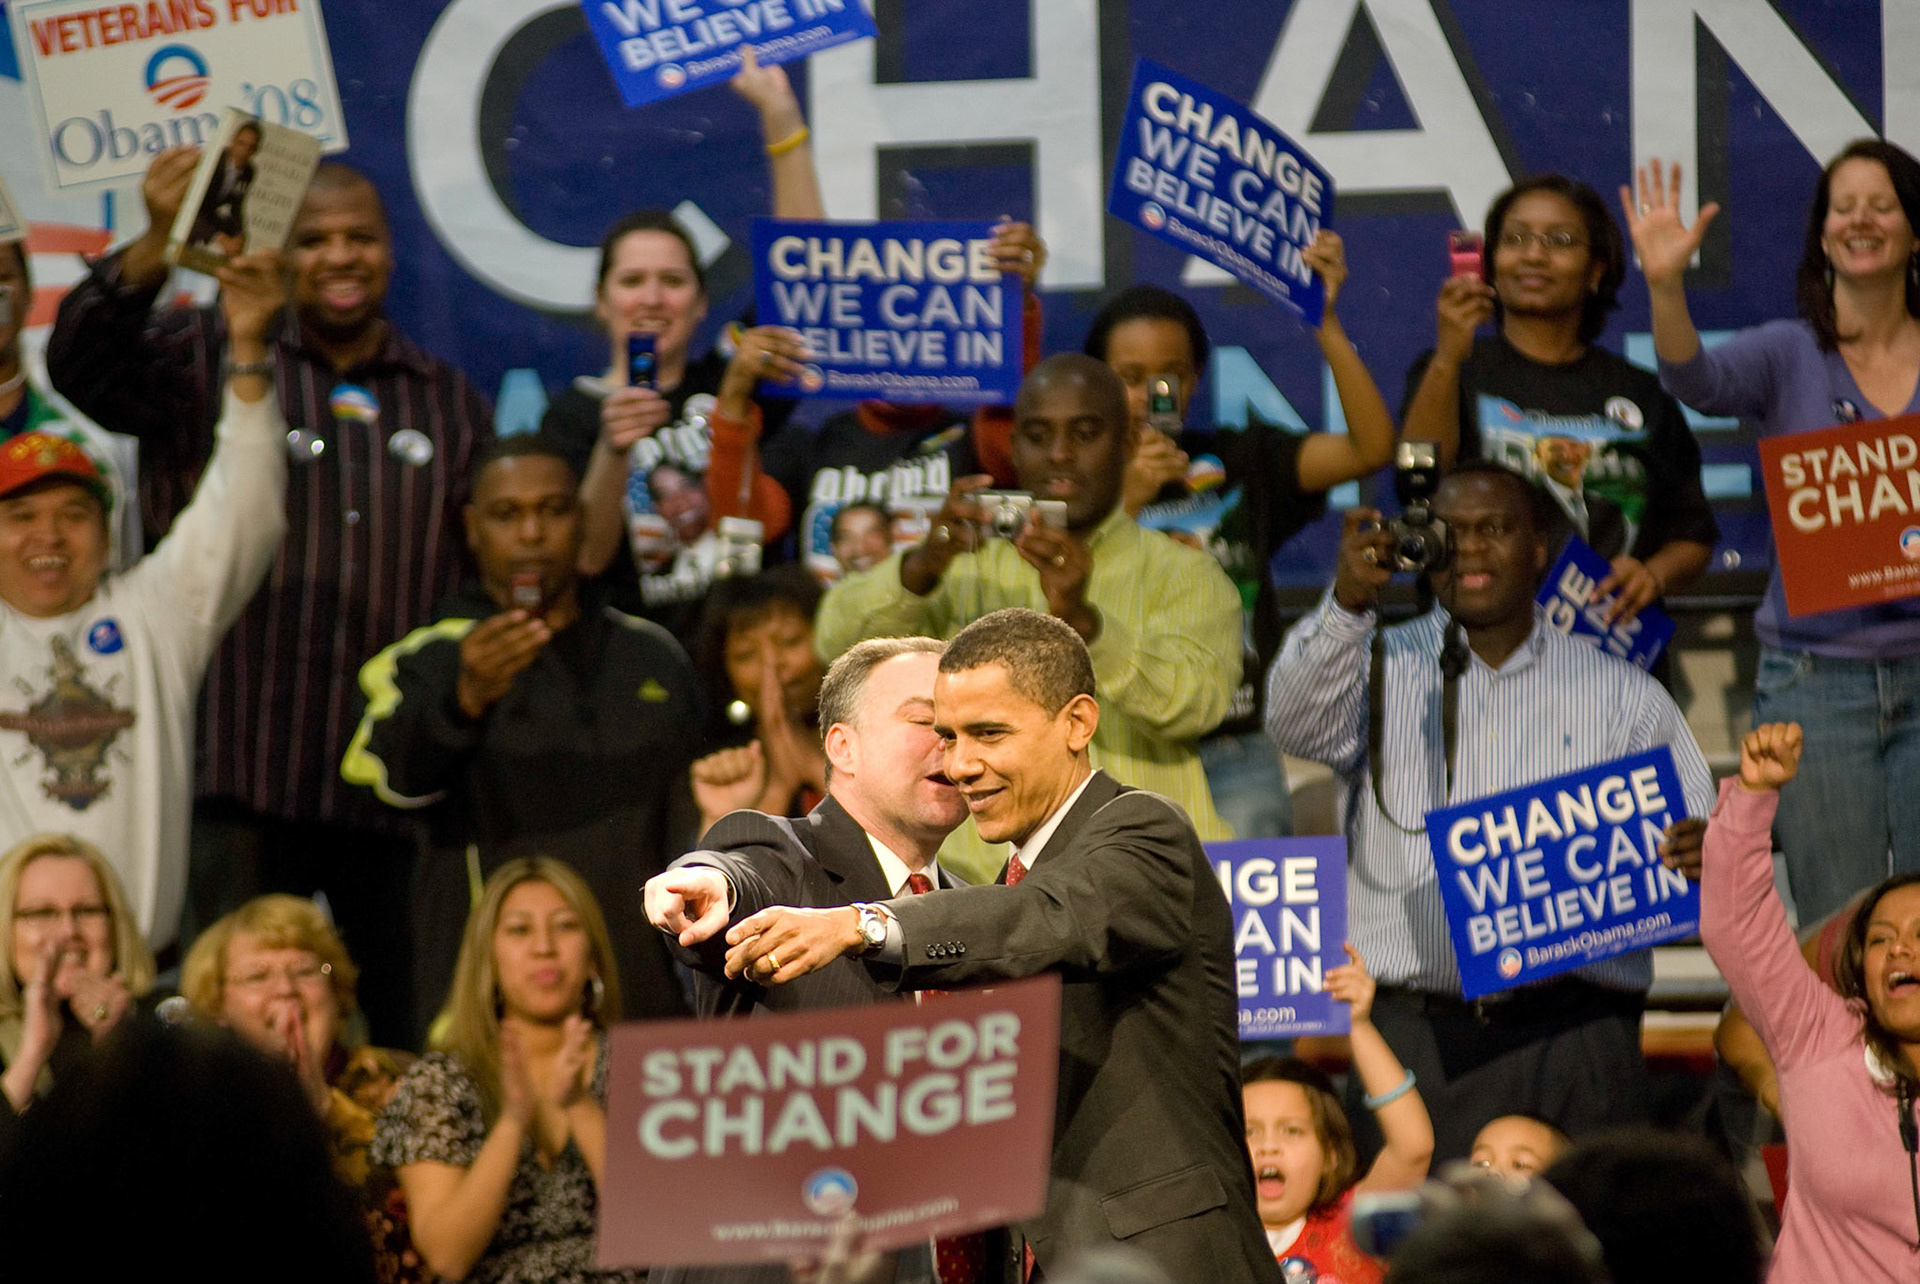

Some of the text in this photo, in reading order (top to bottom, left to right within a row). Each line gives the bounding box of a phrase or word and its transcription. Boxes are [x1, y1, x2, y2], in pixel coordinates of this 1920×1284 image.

[31, 0, 217, 57] VETERANS
[619, 0, 795, 71] BELIEVE
[54, 109, 221, 168] Obam
[1141, 81, 1324, 217] CHANGE
[1125, 157, 1276, 261] BELIEVE
[1137, 117, 1319, 246] WE CAN
[767, 235, 1001, 284] CHANGE
[771, 282, 1003, 328] WE CAN
[800, 326, 1003, 368] ELIEVE IN
[827, 369, 980, 390] BarackObama.com
[1780, 434, 1918, 489] STAND
[1447, 764, 1667, 866] CHANGE
[1457, 811, 1674, 913] WE CAN
[1466, 873, 1636, 956] BELIEVE
[1644, 865, 1689, 905] IN
[1526, 911, 1671, 968] BarackObama.com
[1274, 956, 1322, 996] IN
[641, 1010, 1022, 1097] STAND FOR
[638, 1061, 1018, 1160] CHANGE
